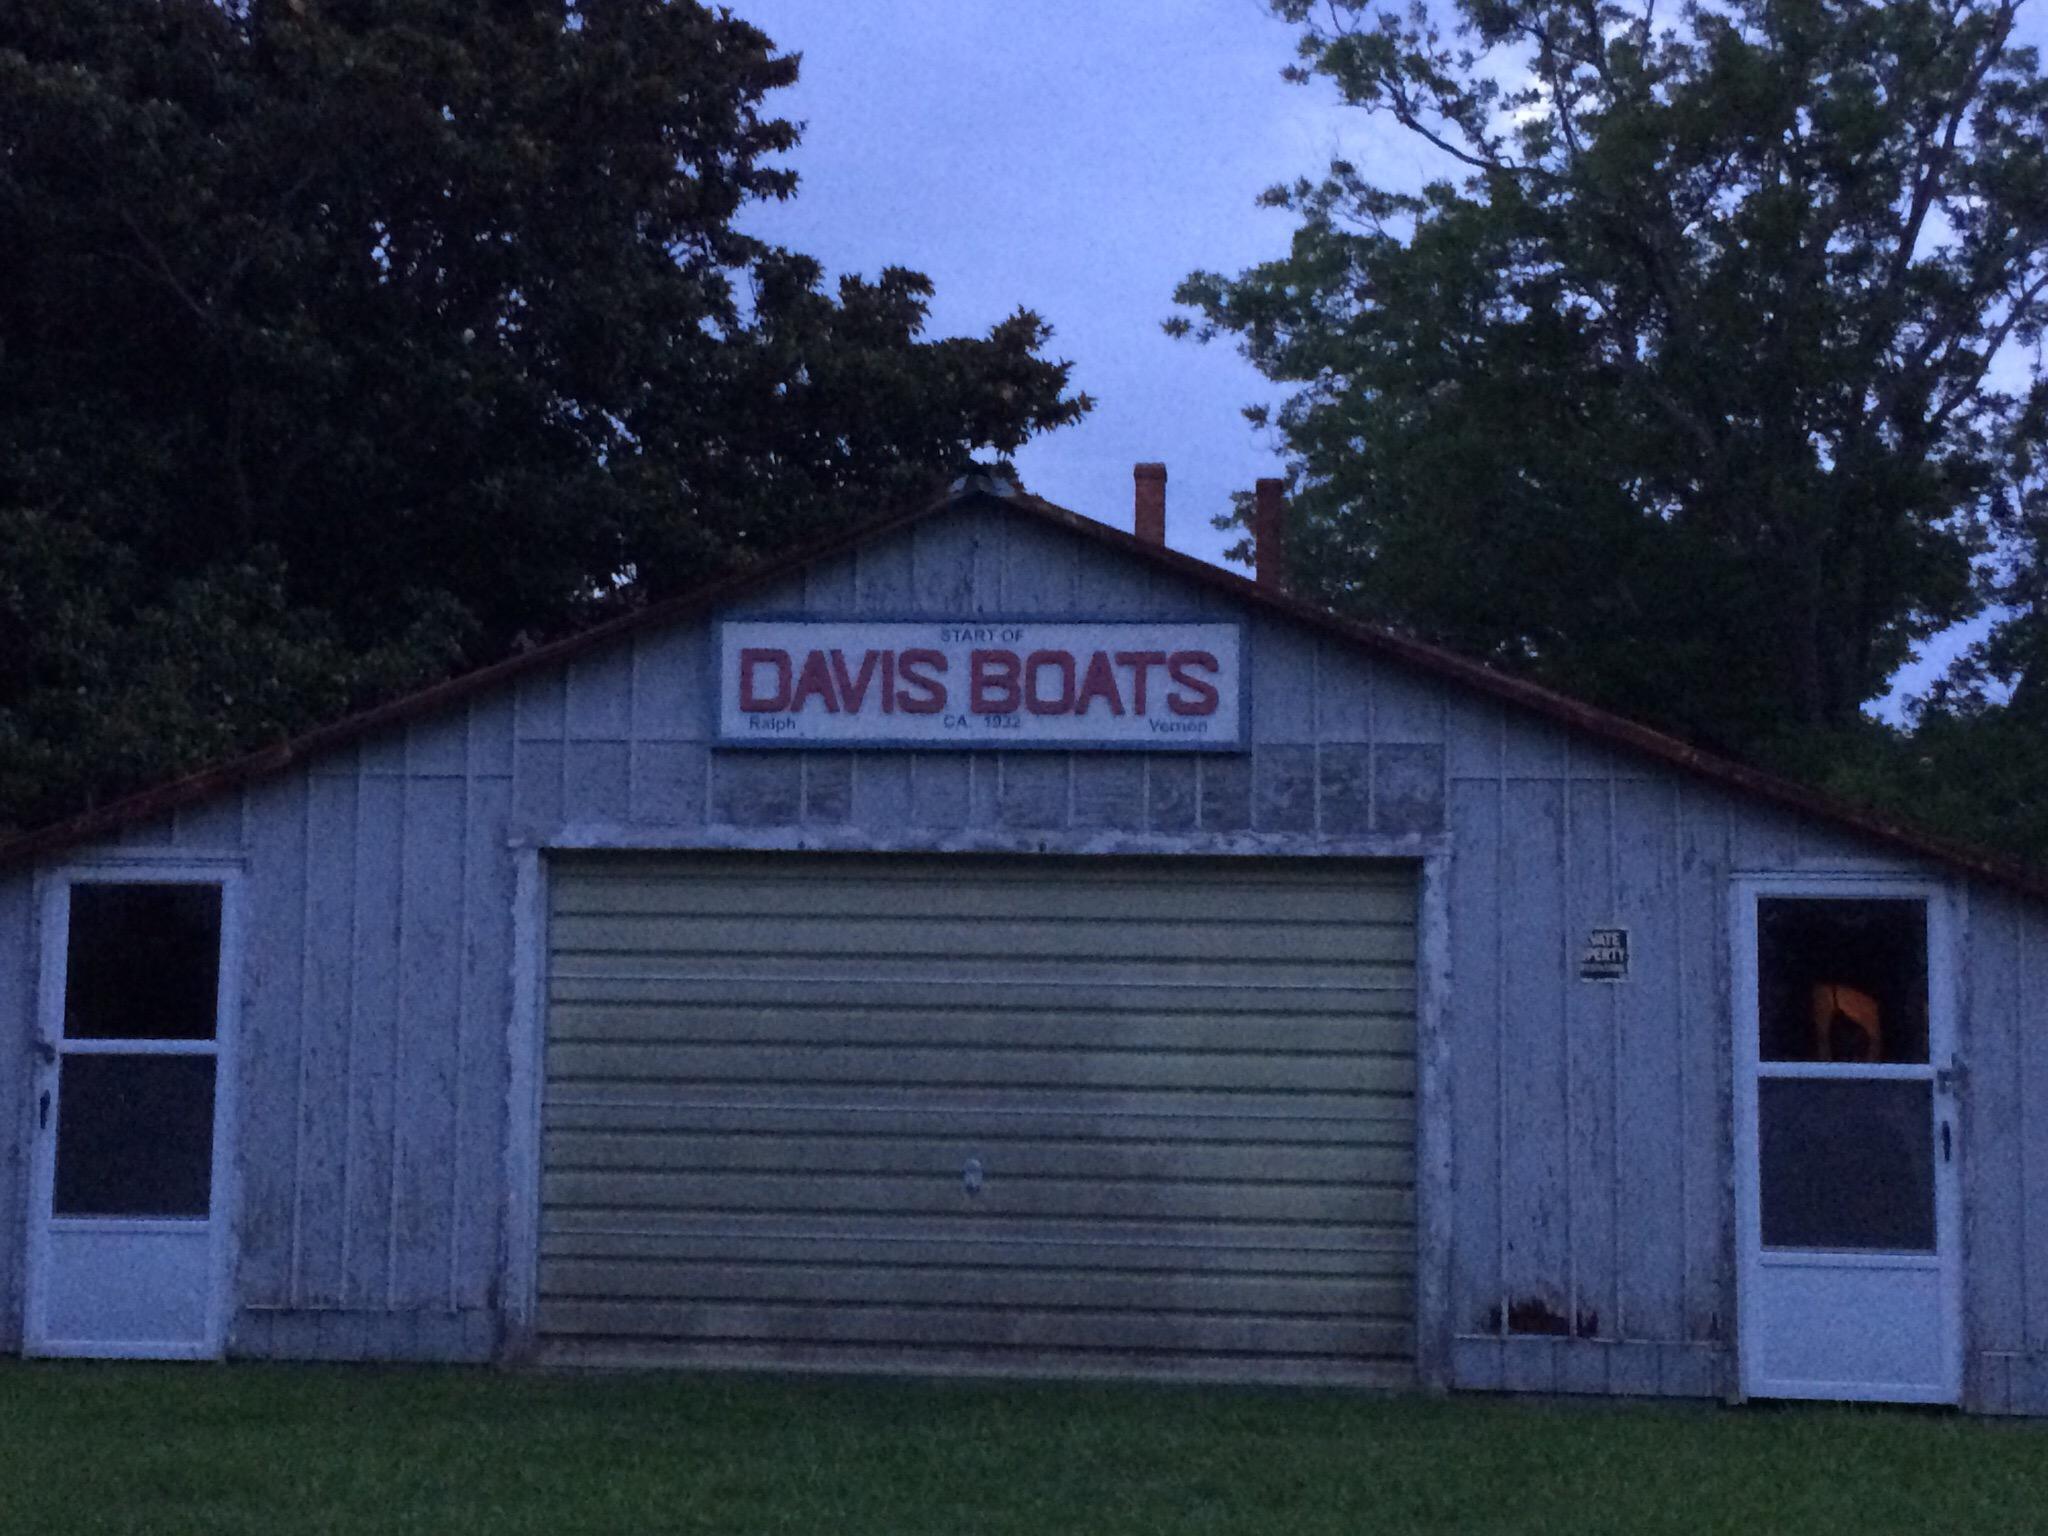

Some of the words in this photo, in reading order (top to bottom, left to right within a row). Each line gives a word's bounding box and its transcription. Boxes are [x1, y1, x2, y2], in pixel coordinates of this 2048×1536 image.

[941, 628, 993, 642] START
[1001, 628, 1025, 642] OF
[739, 648, 948, 714] DAVIS
[970, 648, 1220, 716] BOATS
[749, 716, 796, 733] Ralph
[983, 714, 1021, 729] 1932
[1149, 718, 1208, 734] Vernon
